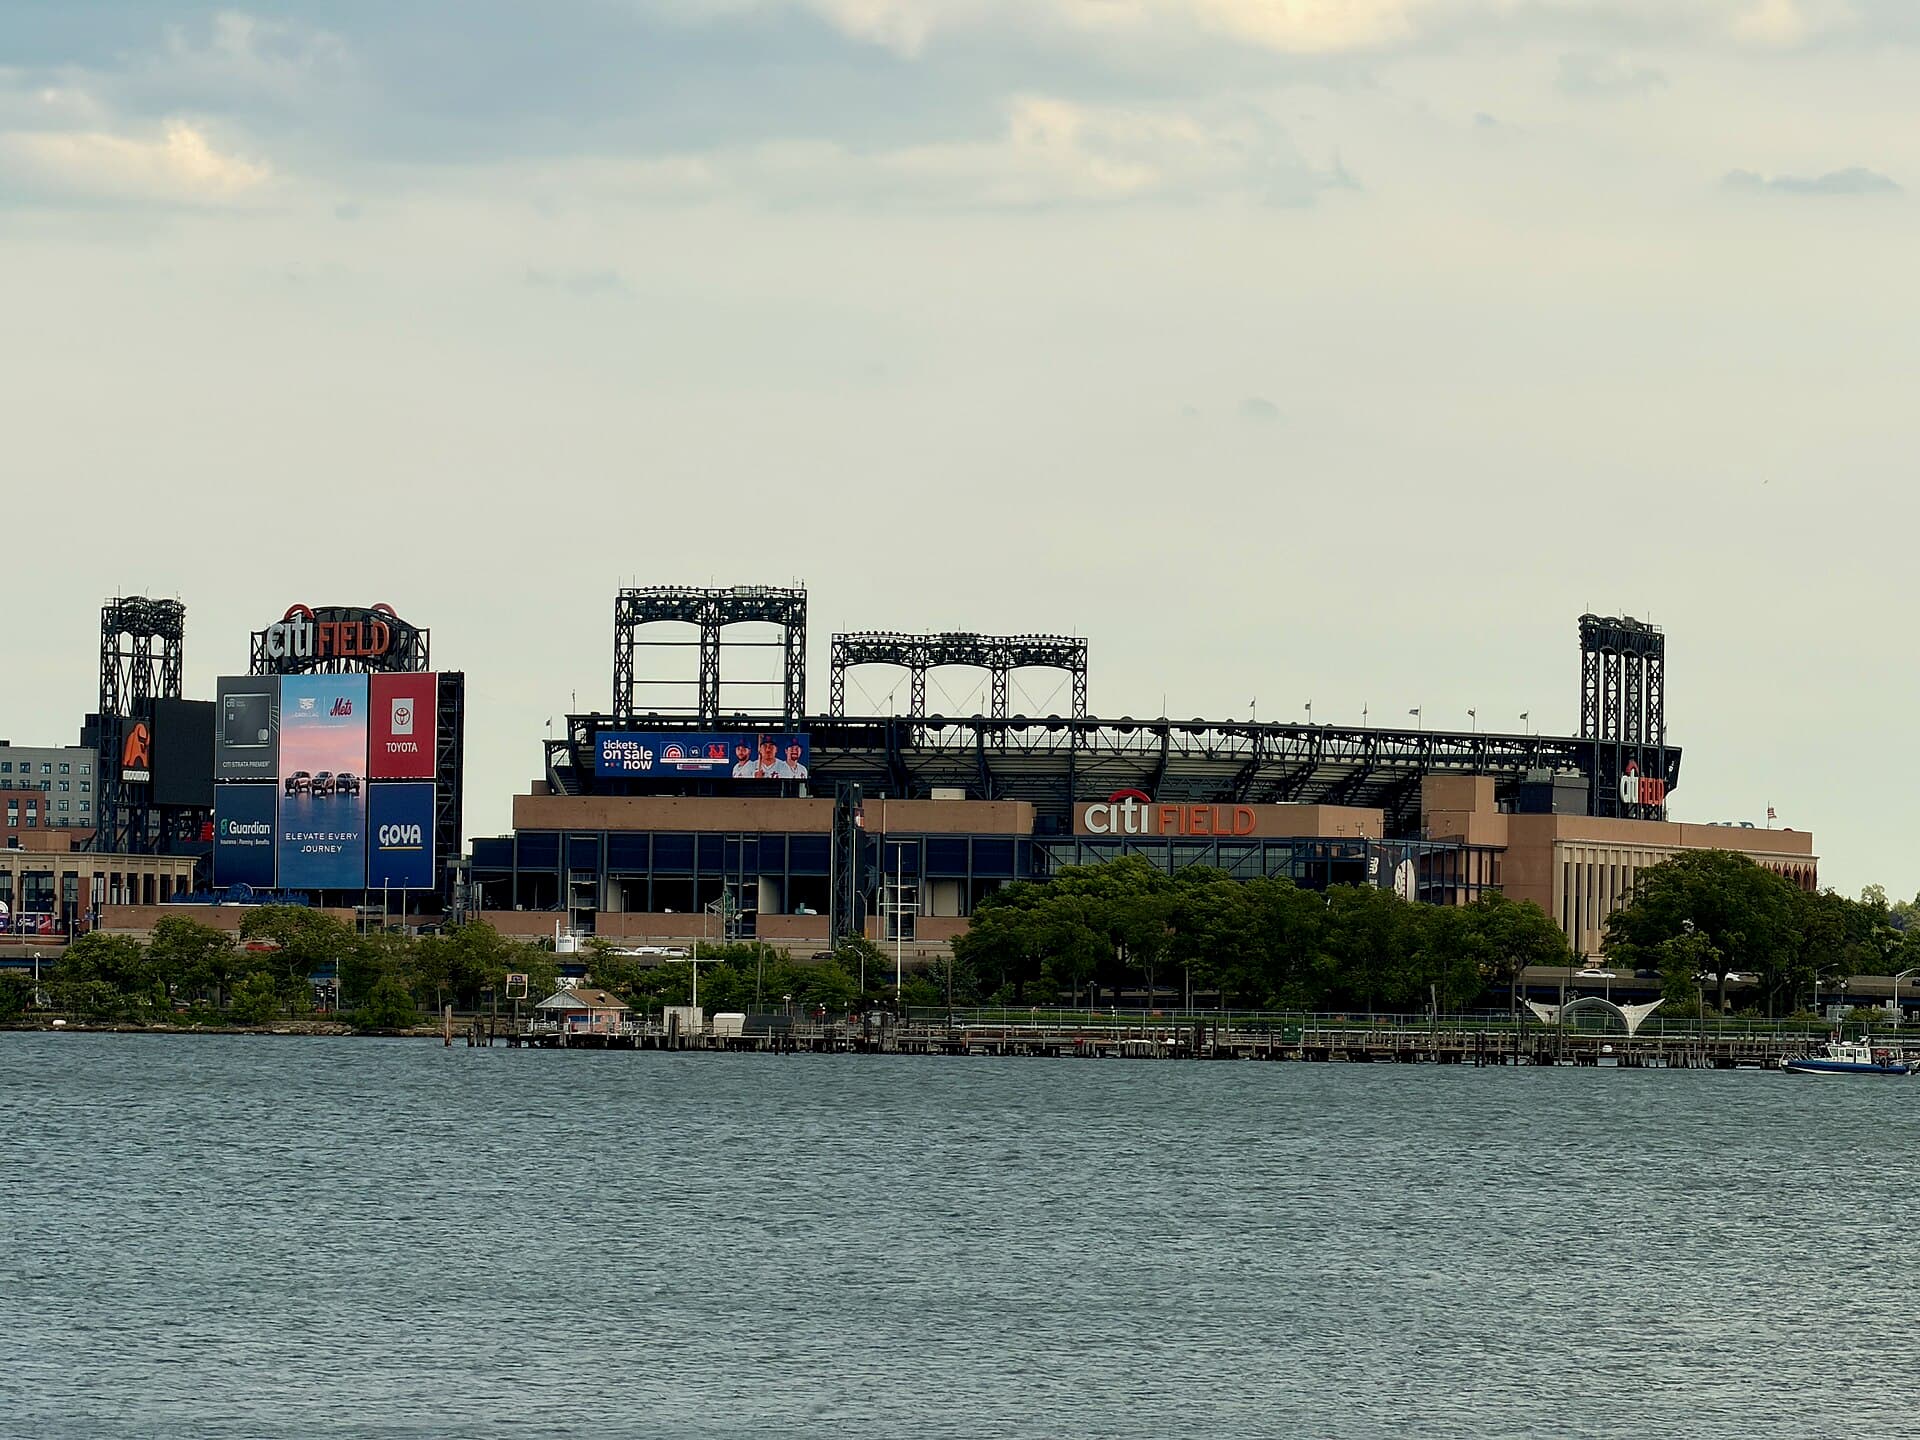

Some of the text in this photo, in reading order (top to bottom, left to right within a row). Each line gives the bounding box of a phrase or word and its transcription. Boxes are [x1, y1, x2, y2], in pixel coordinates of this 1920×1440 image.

[318, 620, 390, 657] FIELD
[329, 697, 352, 717] Mets
[386, 742, 418, 753] TOYOTA
[602, 739, 638, 750] tickets
[603, 749, 622, 760] on
[623, 745, 654, 760] sale
[623, 759, 653, 770] now
[1638, 776, 1665, 805] FIELD
[229, 820, 270, 835] Guardian
[1157, 805, 1256, 836] FIELD
[285, 832, 358, 841] ELEVATE EVERY
[378, 824, 421, 846] GOYA
[300, 844, 342, 854] JOURNEY
